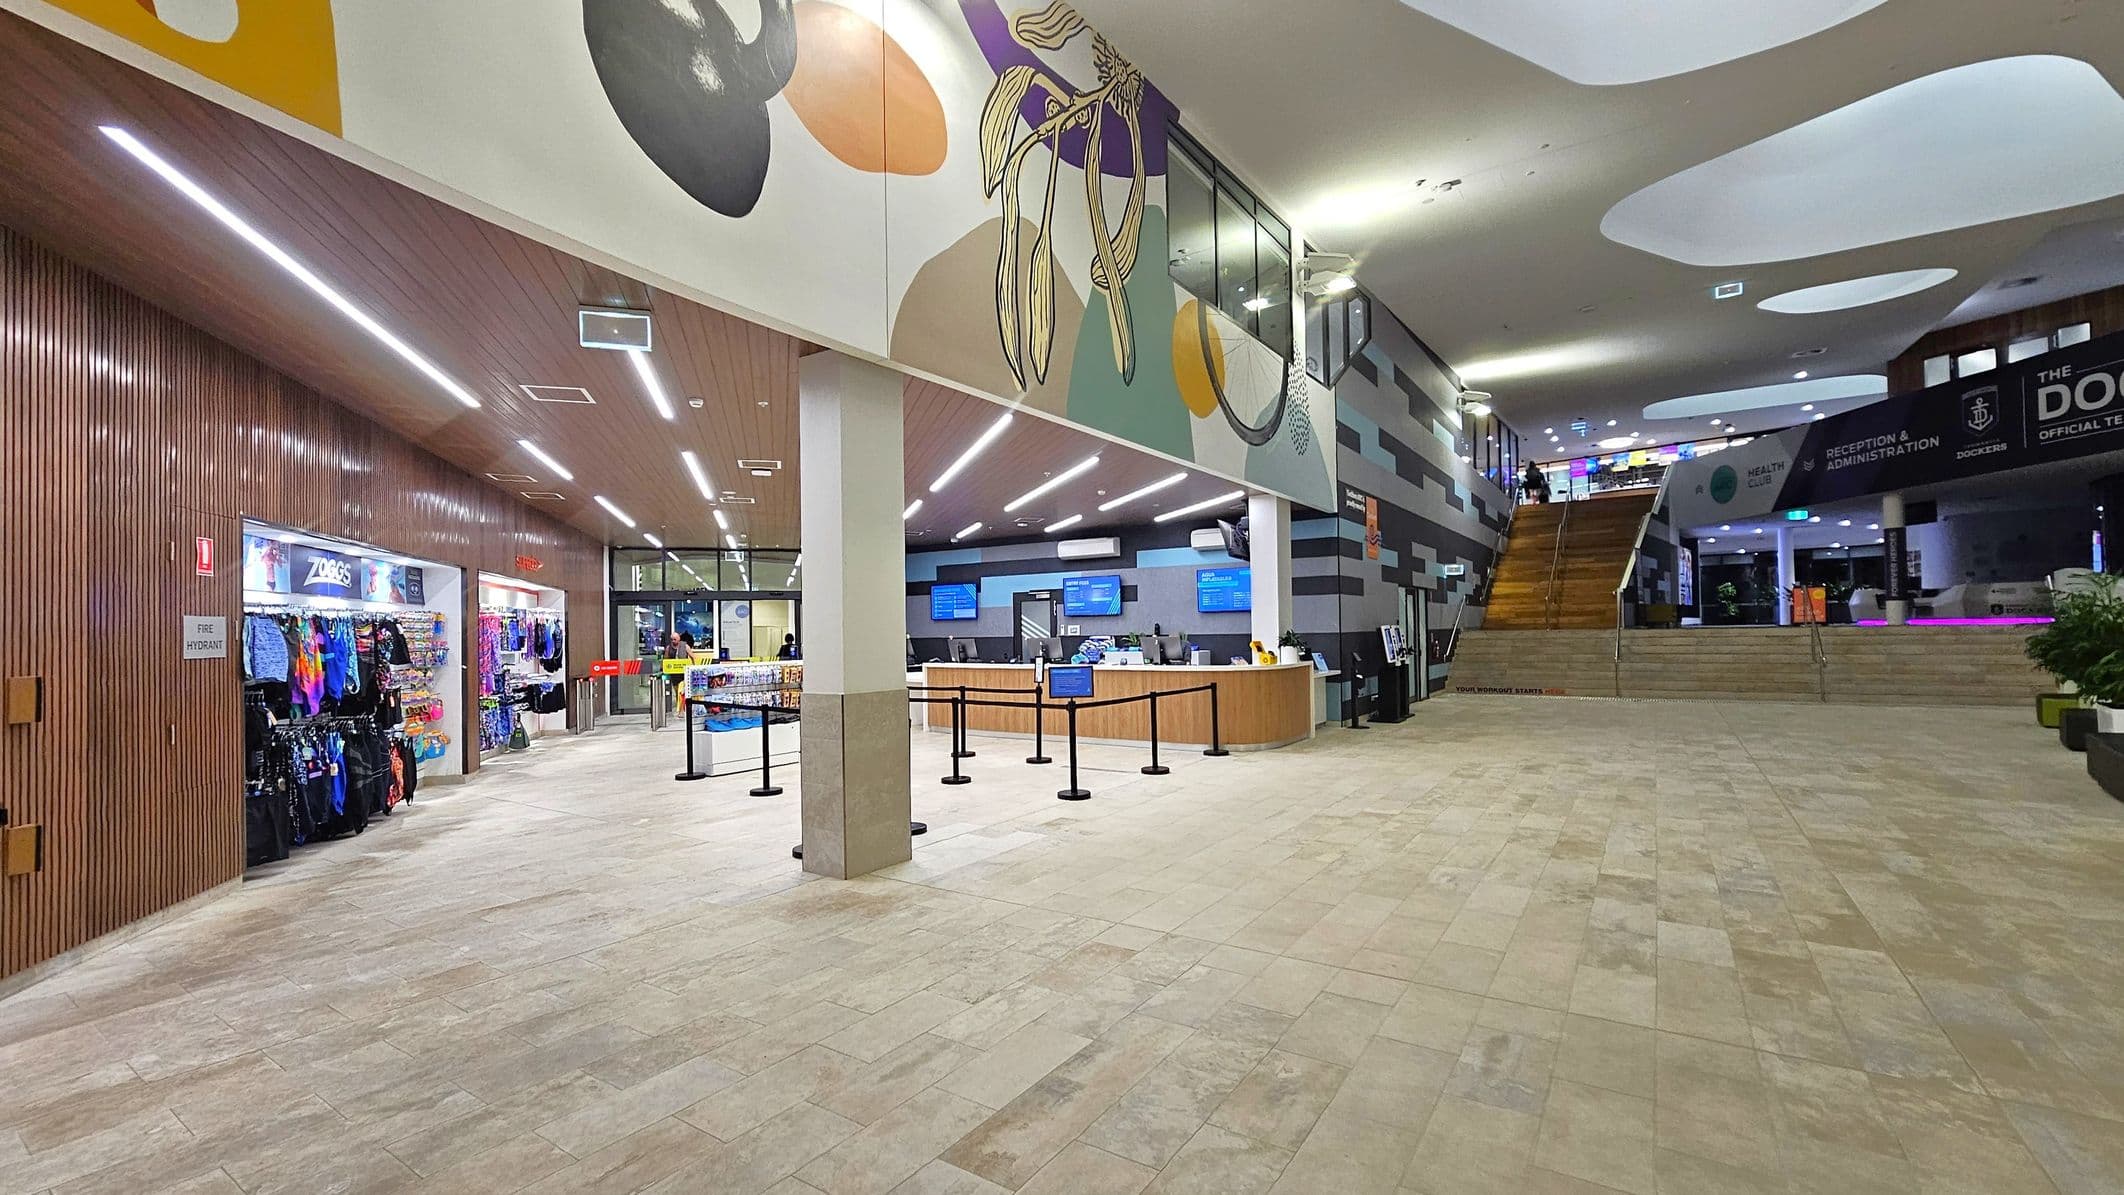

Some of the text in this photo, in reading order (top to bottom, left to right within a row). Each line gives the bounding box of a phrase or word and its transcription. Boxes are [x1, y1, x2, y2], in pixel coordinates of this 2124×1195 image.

[2037, 364, 2072, 383] THE
[2037, 371, 2124, 421] DO
[2039, 420, 2101, 440] OFFICIAL
[1826, 430, 1909, 459] RECEPTION &
[1827, 435, 1940, 471] ADMINISTRATION
[1956, 443, 2007, 460] DOCKERS
[1747, 461, 1785, 478] HEALTH
[1747, 474, 1772, 488] CLUB
[303, 555, 352, 588] ZOGGS
[197, 623, 214, 634] FIRE
[187, 640, 223, 651] HYDRANT
